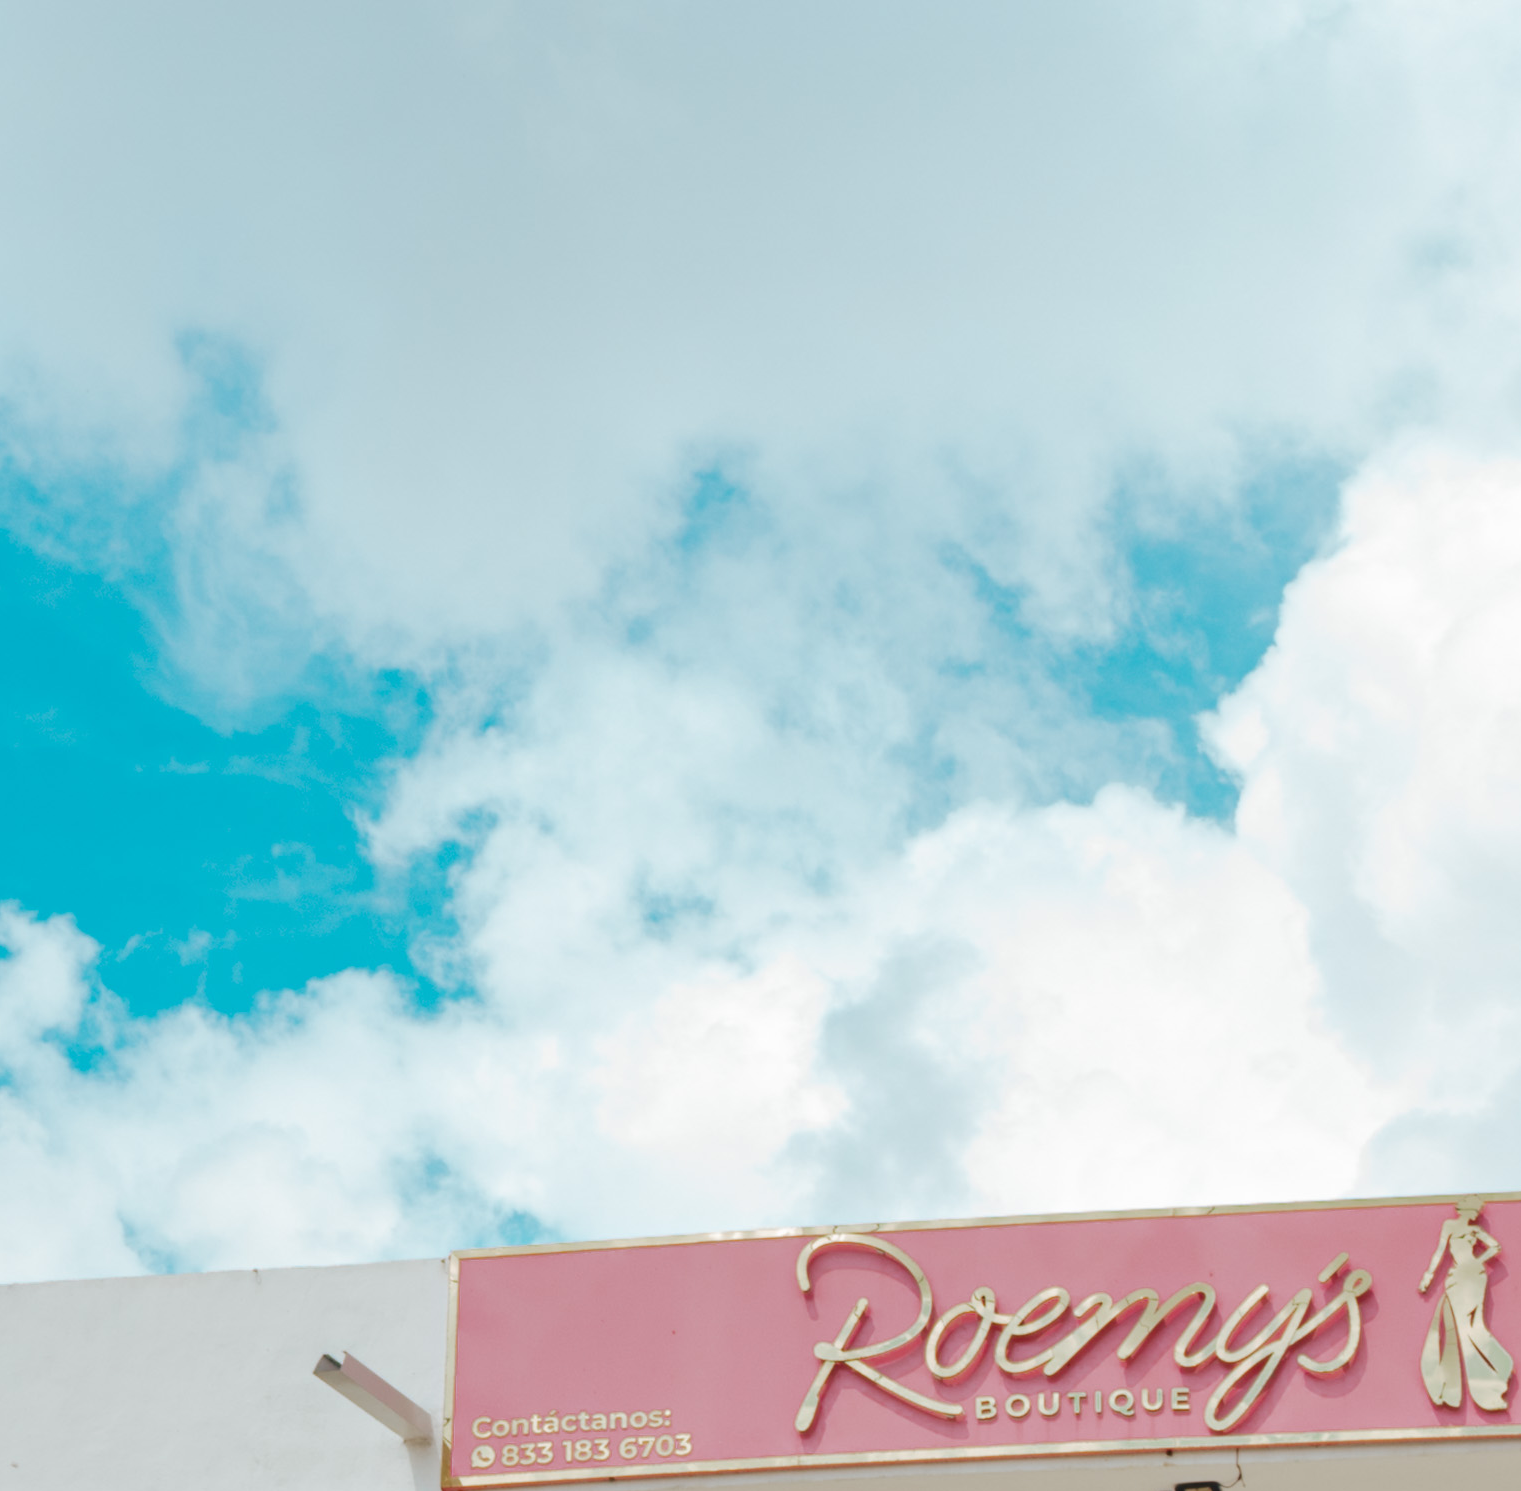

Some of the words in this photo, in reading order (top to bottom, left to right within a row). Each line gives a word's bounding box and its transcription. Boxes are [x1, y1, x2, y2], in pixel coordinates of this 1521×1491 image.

[794, 1233, 1373, 1433] Roemy's
[975, 1387, 1192, 1420] BOUTIQUE
[471, 1409, 672, 1439] Contáctanos:
[501, 1441, 554, 1467] 833
[562, 1438, 610, 1463] 183
[619, 1433, 693, 1459] 6703
